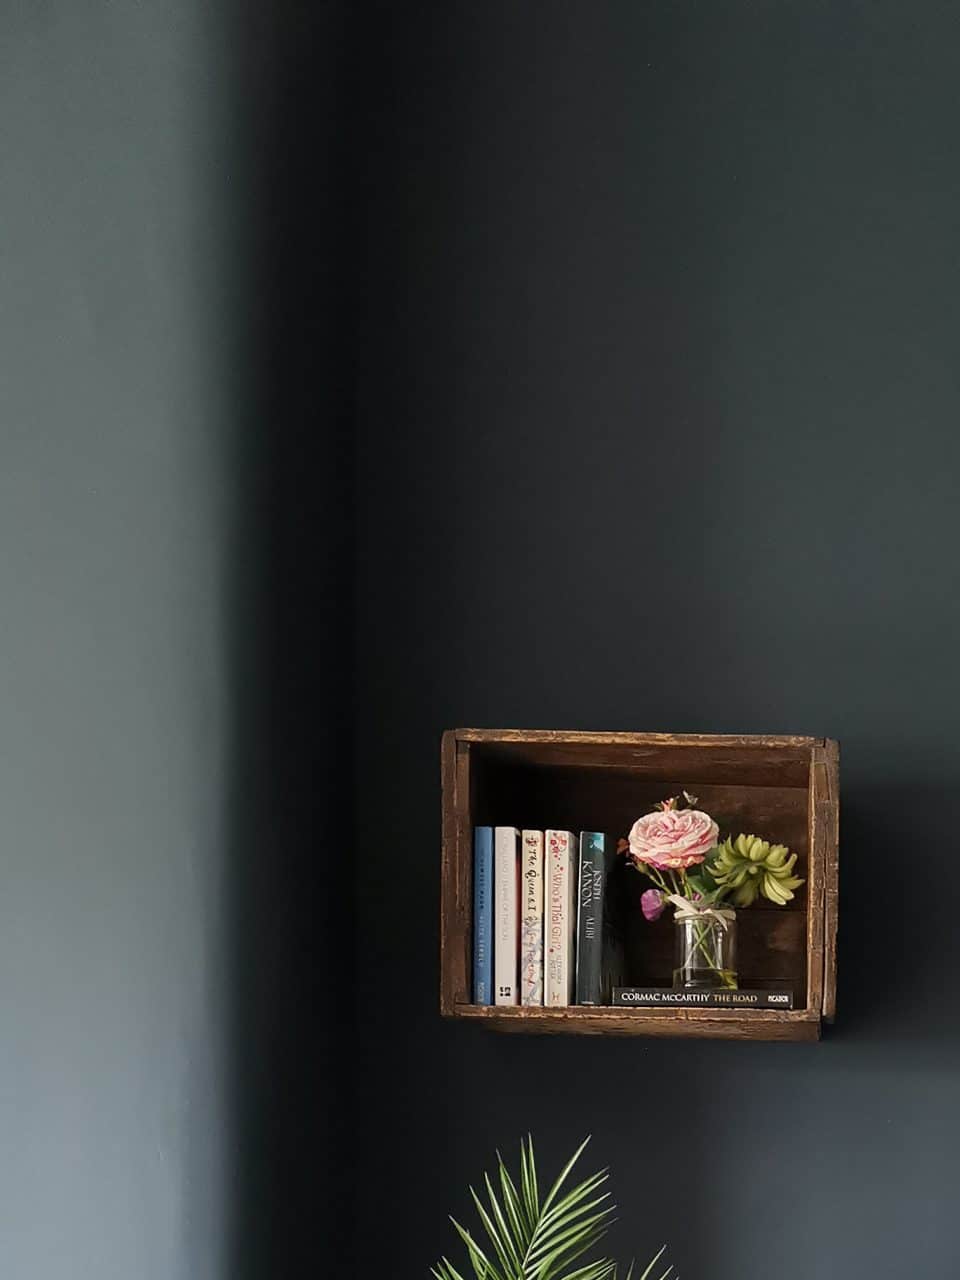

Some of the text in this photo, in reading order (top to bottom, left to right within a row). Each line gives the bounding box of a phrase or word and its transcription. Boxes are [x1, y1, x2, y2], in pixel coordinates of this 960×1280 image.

[527, 849, 537, 867] The
[524, 870, 537, 896] Queen
[551, 873, 562, 902] Who's
[581, 861, 593, 907] KANON
[551, 905, 562, 925] That
[551, 926, 562, 950] Girl?
[621, 993, 758, 1003] CORMAC McCARTHY THE ROAD
